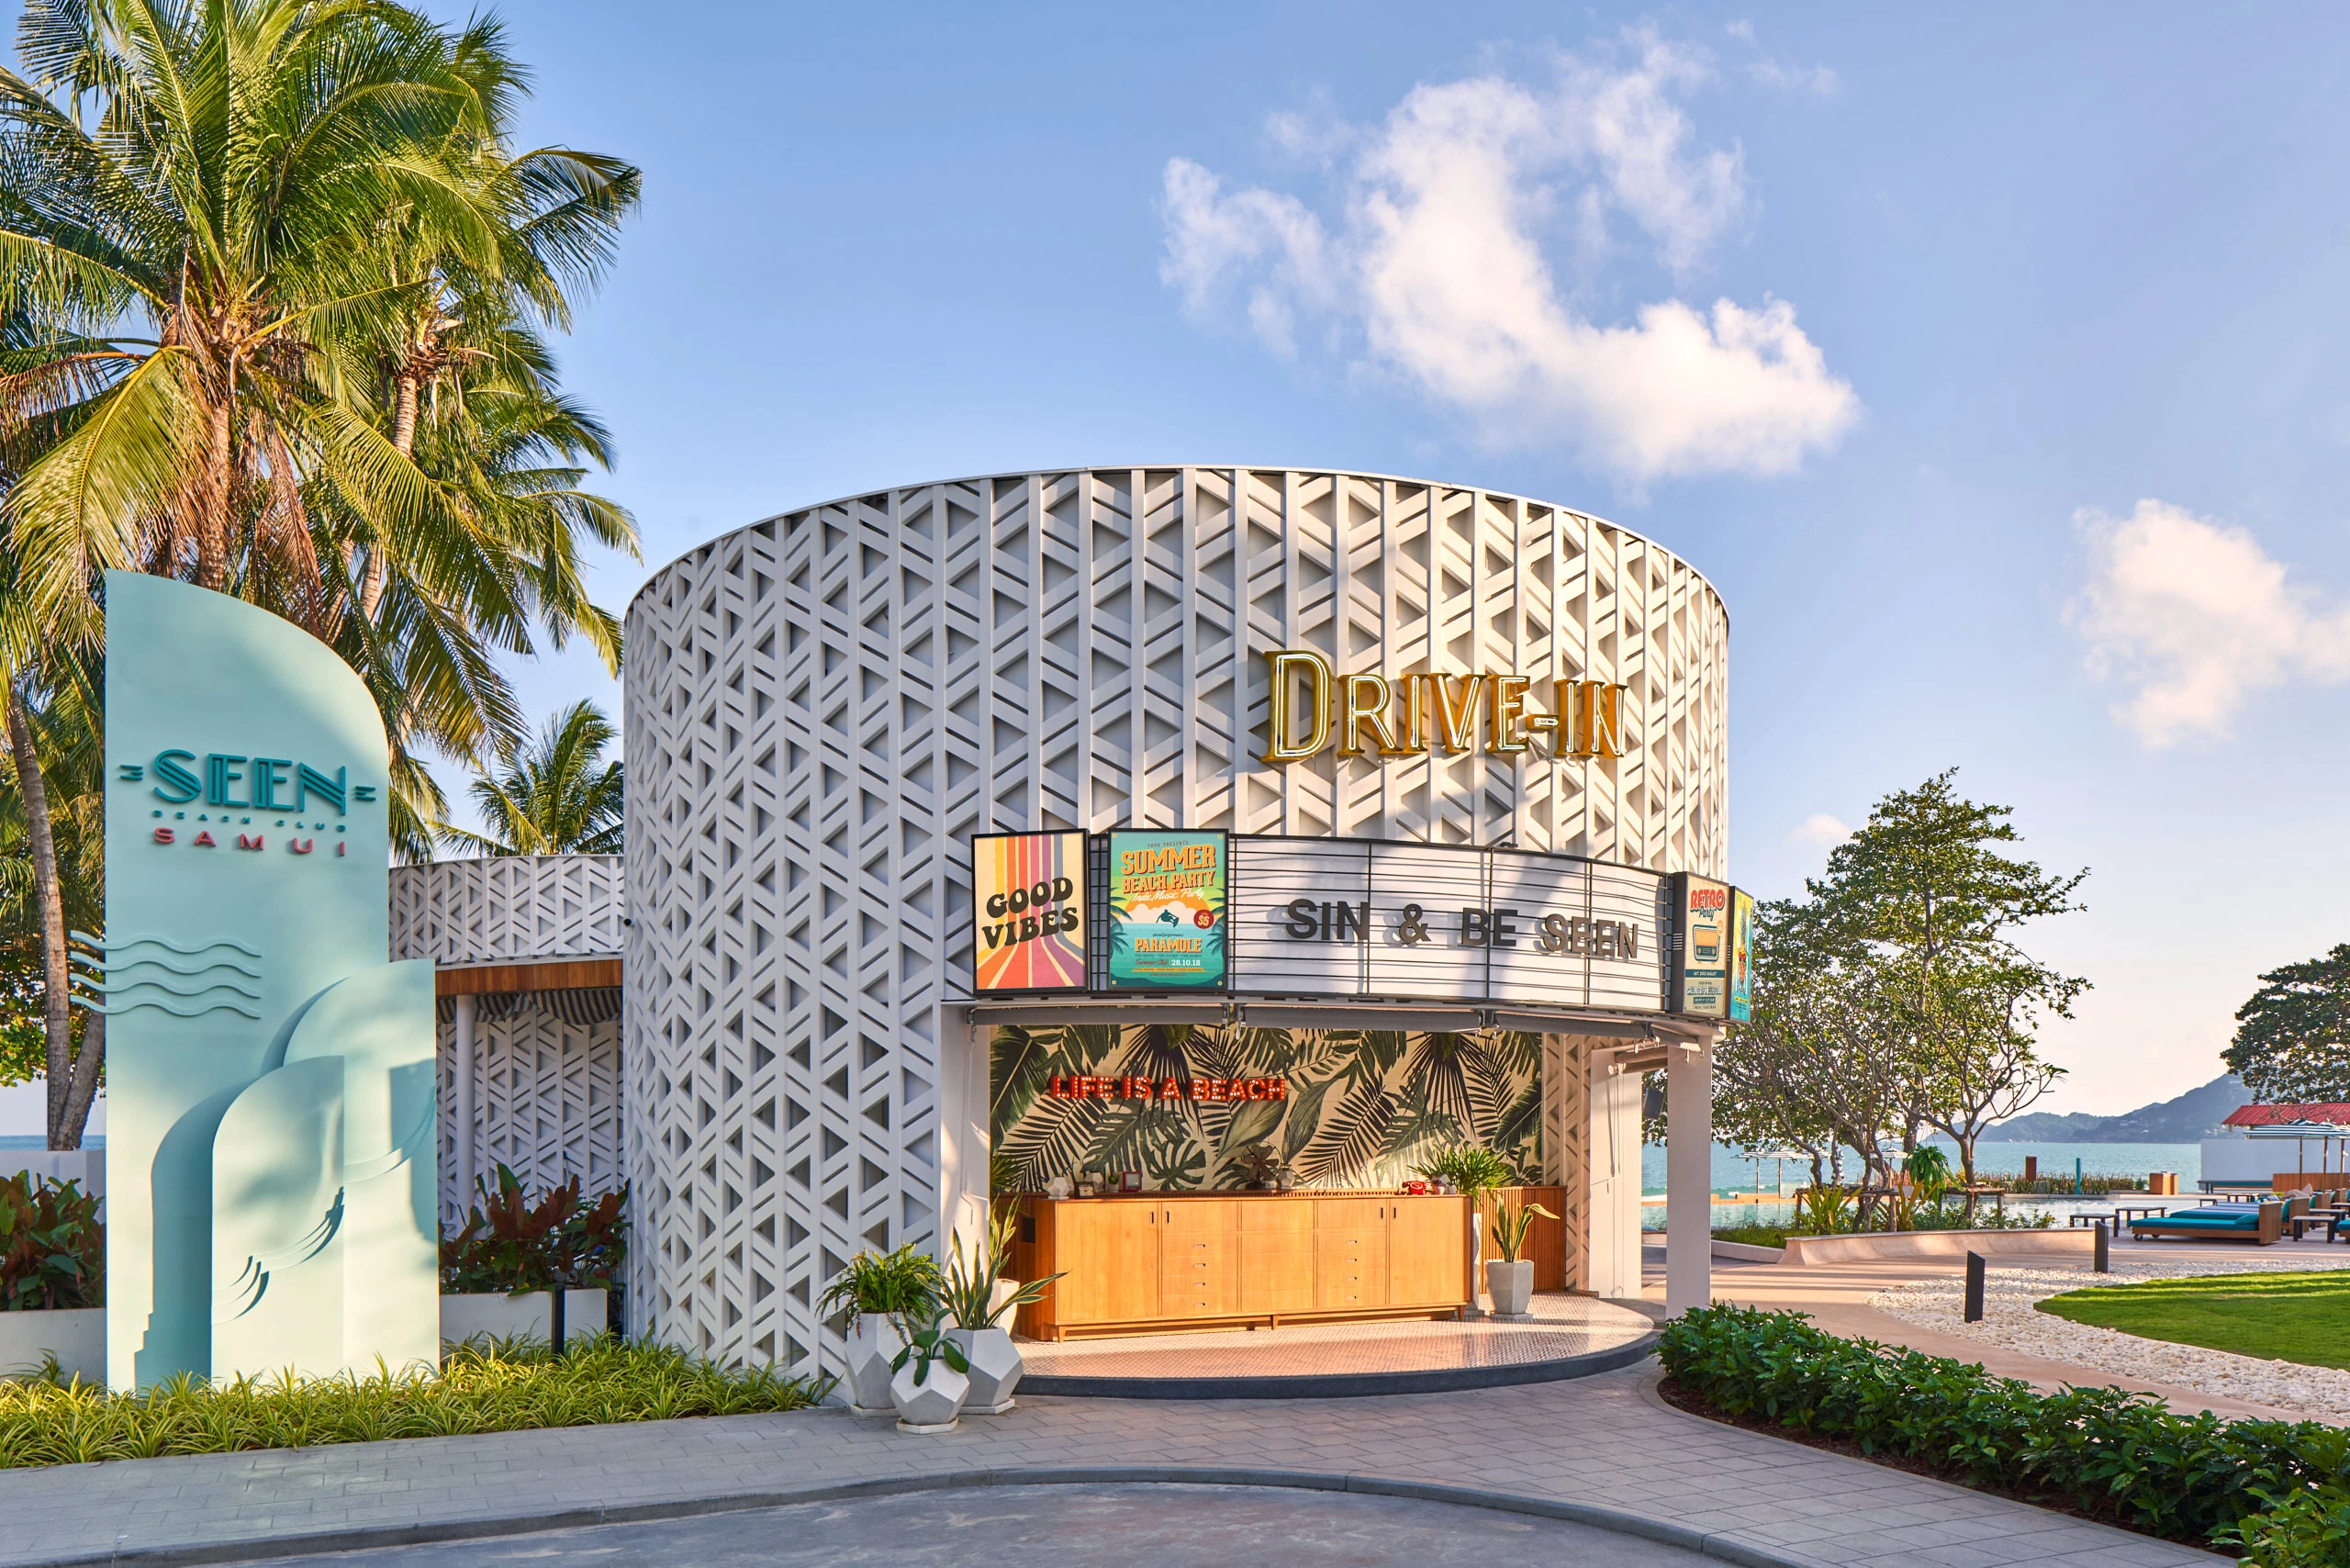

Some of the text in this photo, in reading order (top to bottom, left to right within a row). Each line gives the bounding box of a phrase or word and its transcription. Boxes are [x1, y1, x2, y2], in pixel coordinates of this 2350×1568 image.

[1261, 650, 1628, 762] DRIVE-IN
[153, 748, 346, 816] SEEN
[152, 810, 251, 825] BEACH
[275, 820, 346, 832] CLUB
[153, 827, 346, 857] SAMUI
[1121, 844, 1216, 876] SUMMER
[1123, 869, 1215, 894] BEACH PARTY
[986, 877, 1073, 918] GOOD
[1151, 889, 1179, 902] Music
[1181, 888, 1205, 901] Party
[1690, 889, 1726, 911] RETRO
[1698, 905, 1715, 922] Party
[981, 907, 1079, 949] VIBES
[1286, 899, 1639, 958] SIN & BE SEEN
[1135, 937, 1203, 953] PARAMOLE
[1050, 1075, 1285, 1101] LIFE IS A BEACH
